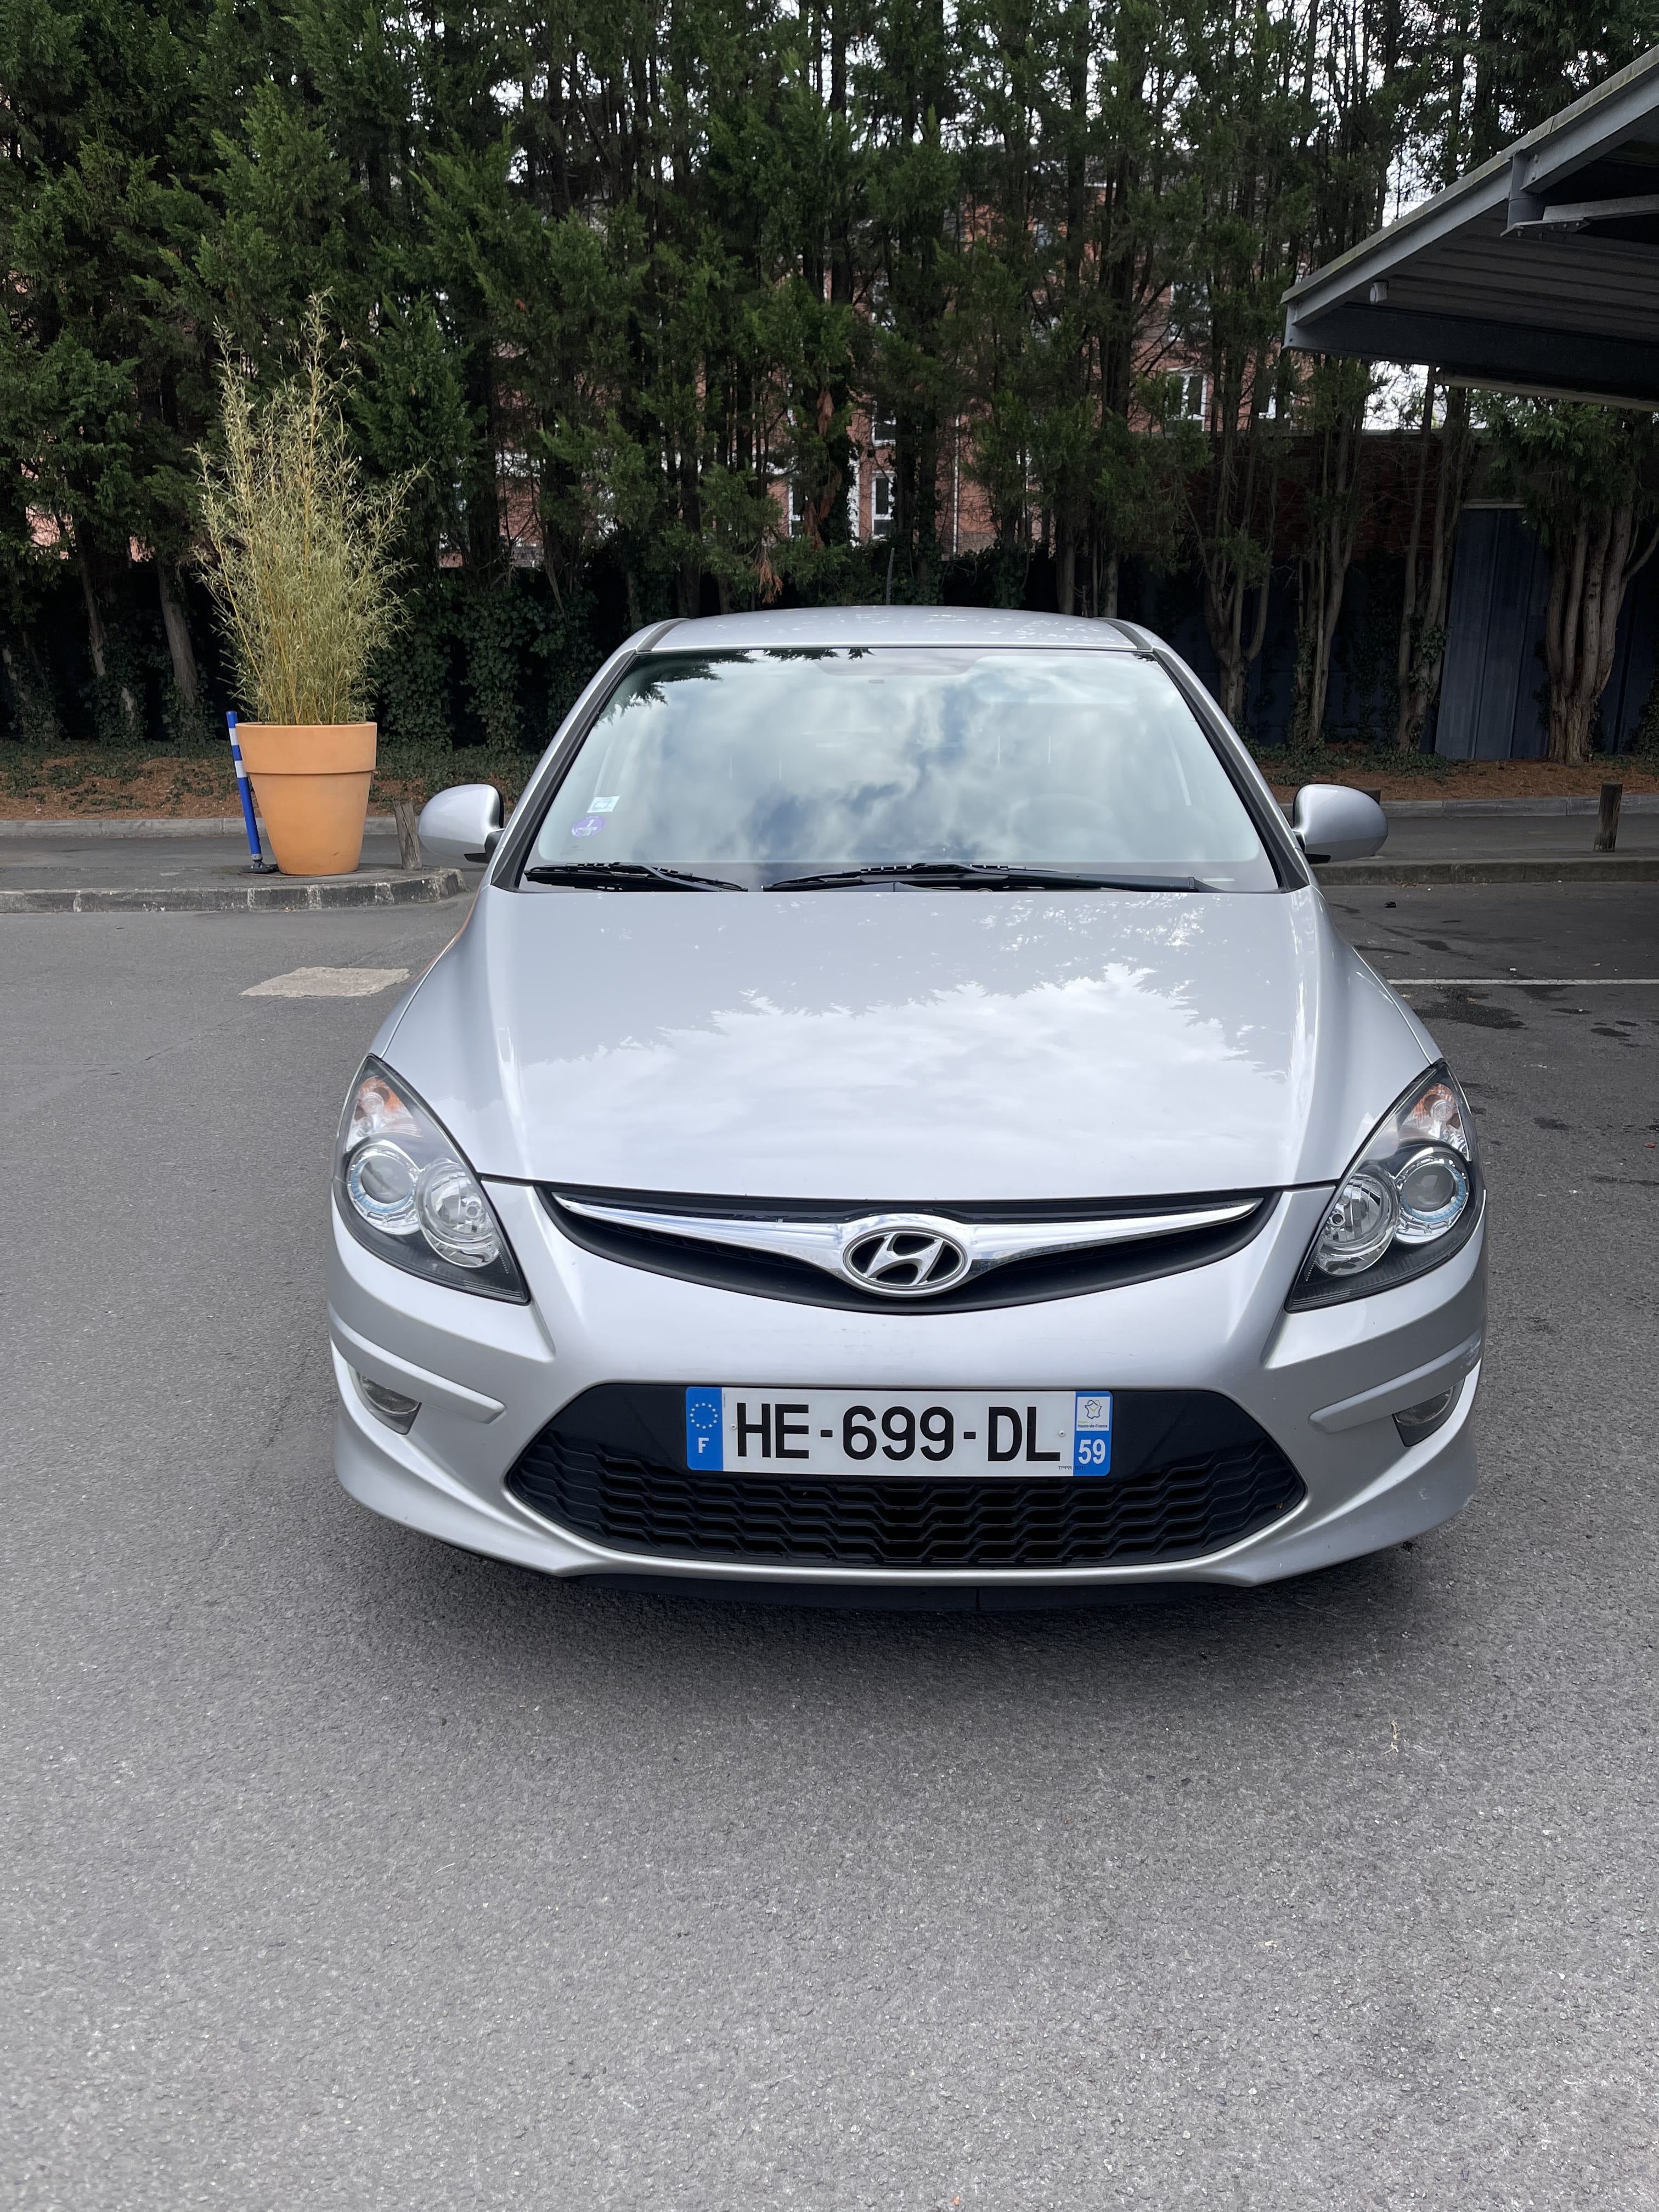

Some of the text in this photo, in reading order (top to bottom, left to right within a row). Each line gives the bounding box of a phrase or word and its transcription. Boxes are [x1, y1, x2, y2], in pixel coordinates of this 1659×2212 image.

[737, 1402, 1060, 1462] HE-699-DL
[698, 1437, 709, 1453] F
[1078, 1439, 1106, 1464] 59
